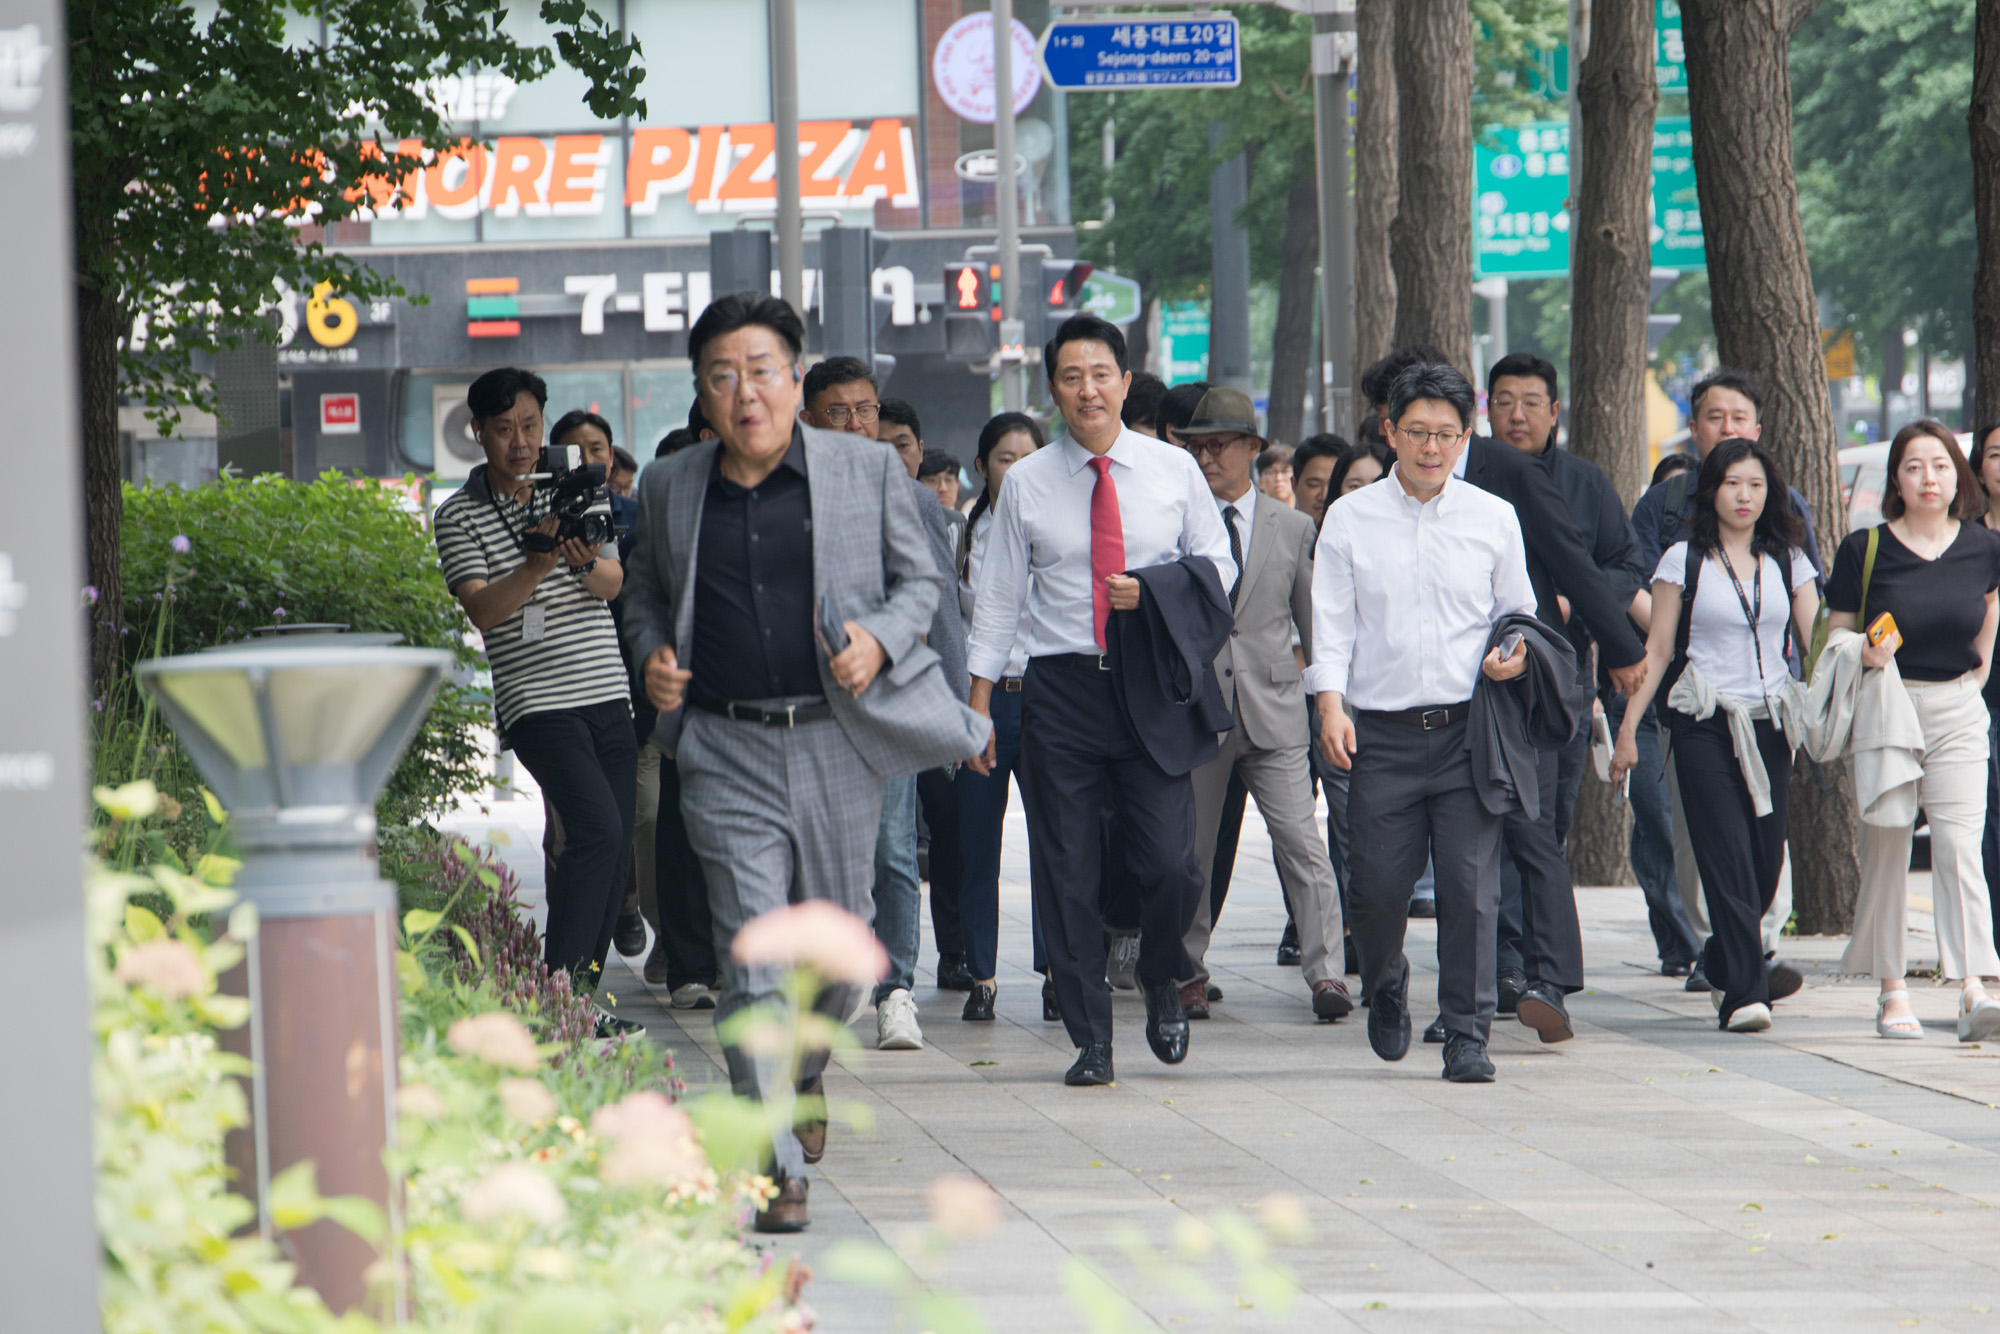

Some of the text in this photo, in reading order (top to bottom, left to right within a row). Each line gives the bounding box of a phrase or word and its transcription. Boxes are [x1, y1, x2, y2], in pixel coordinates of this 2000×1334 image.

[1111, 24, 1233, 48] 세종대로20길
[1097, 49, 1233, 69] Sejong-daero 20-gil
[624, 118, 920, 216] PIZZA
